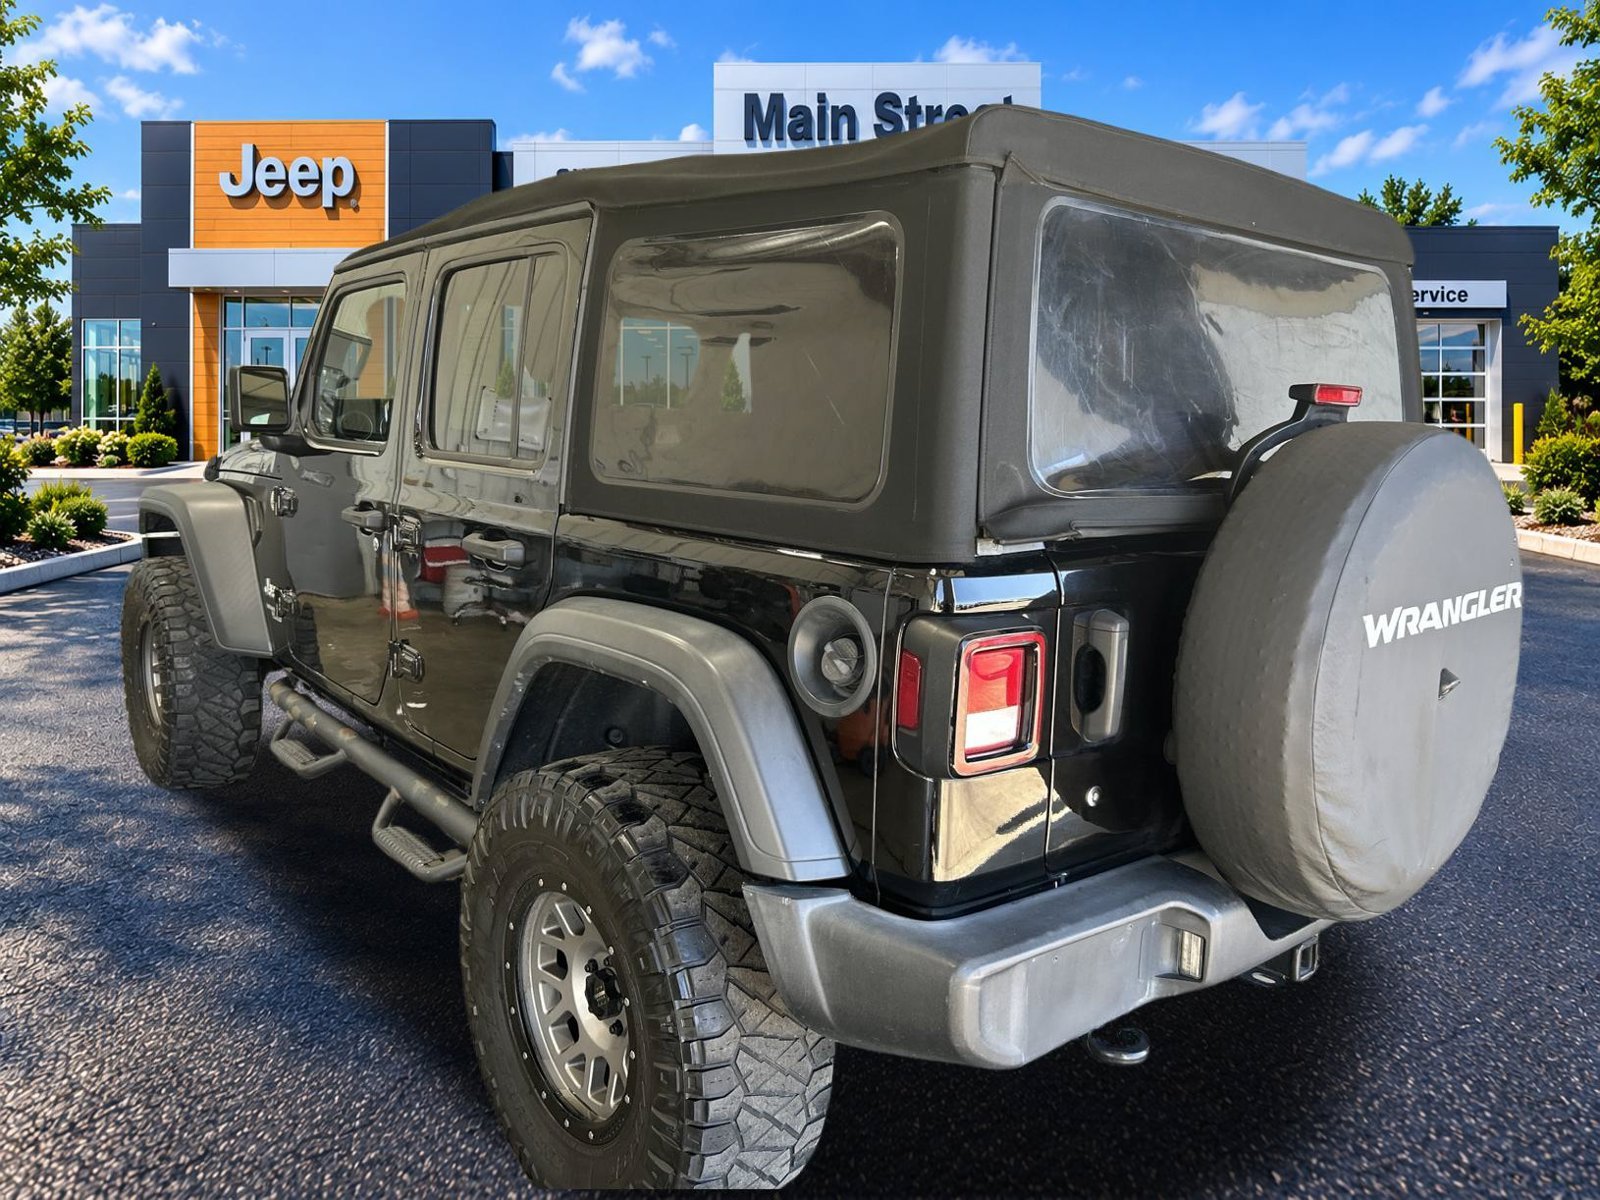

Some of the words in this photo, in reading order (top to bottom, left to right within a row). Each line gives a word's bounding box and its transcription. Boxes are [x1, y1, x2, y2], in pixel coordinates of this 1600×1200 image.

[744, 92, 856, 141] Main
[219, 143, 355, 208] Jeep
[1412, 286, 1469, 303] ervice
[1362, 581, 1522, 649] WRANGLER
